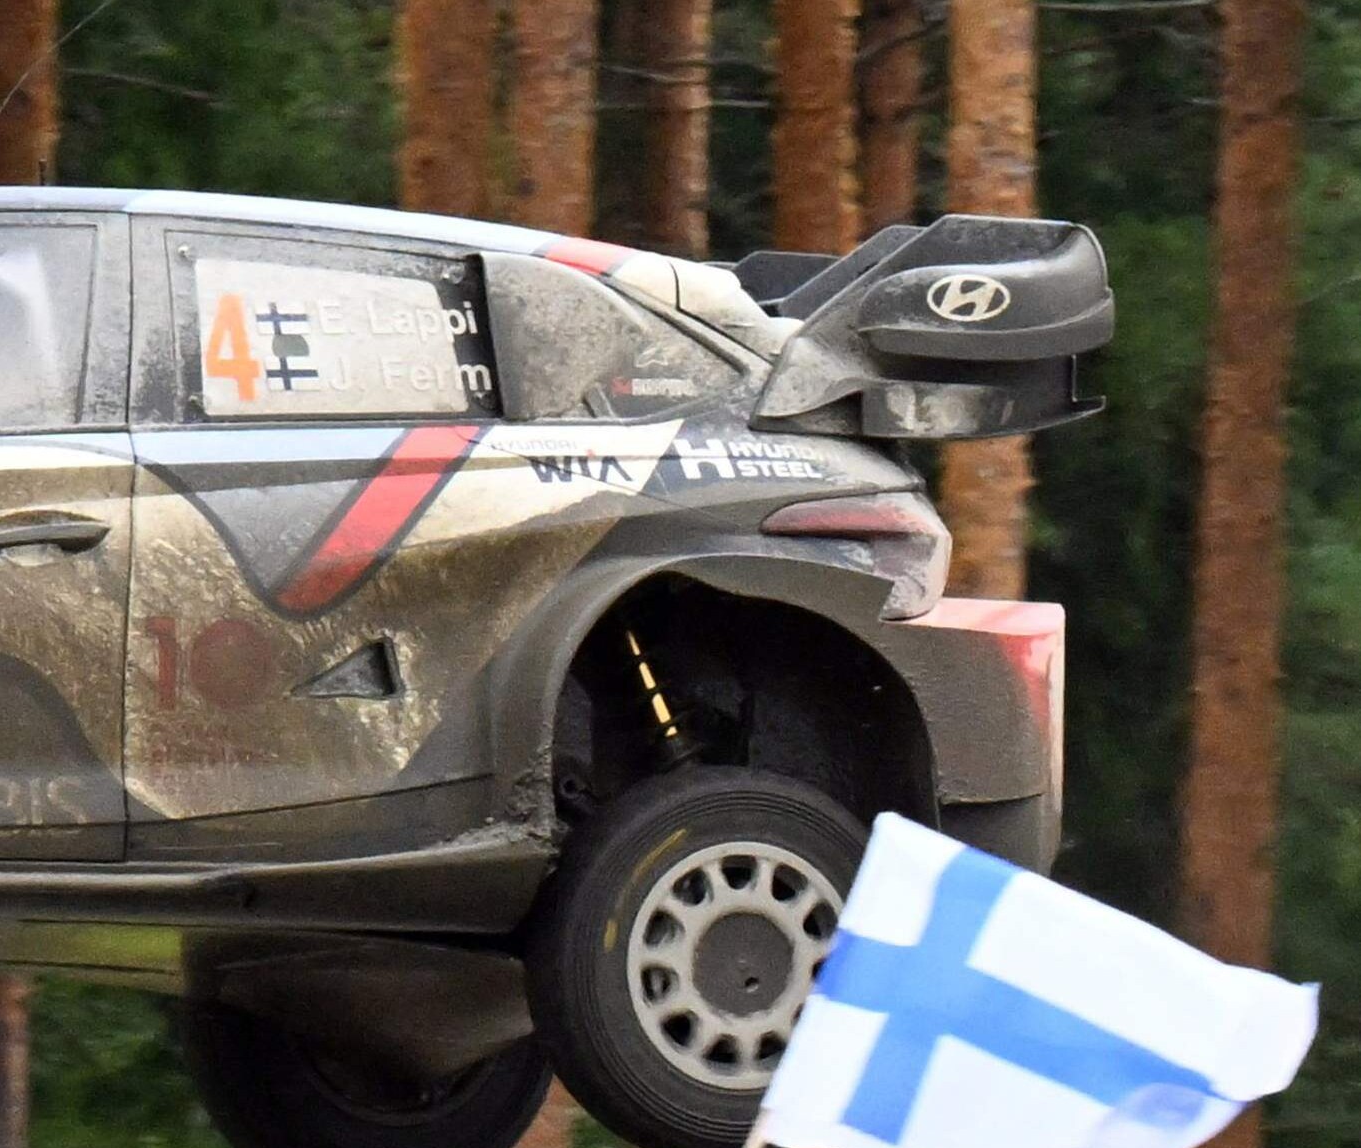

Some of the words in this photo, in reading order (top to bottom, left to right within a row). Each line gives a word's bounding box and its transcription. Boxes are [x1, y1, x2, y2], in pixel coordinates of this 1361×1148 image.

[205, 293, 261, 402] 4
[318, 299, 356, 335] E.
[367, 301, 479, 344] Lappi
[382, 357, 493, 392] Ferm
[736, 460, 823, 479] STEEL
